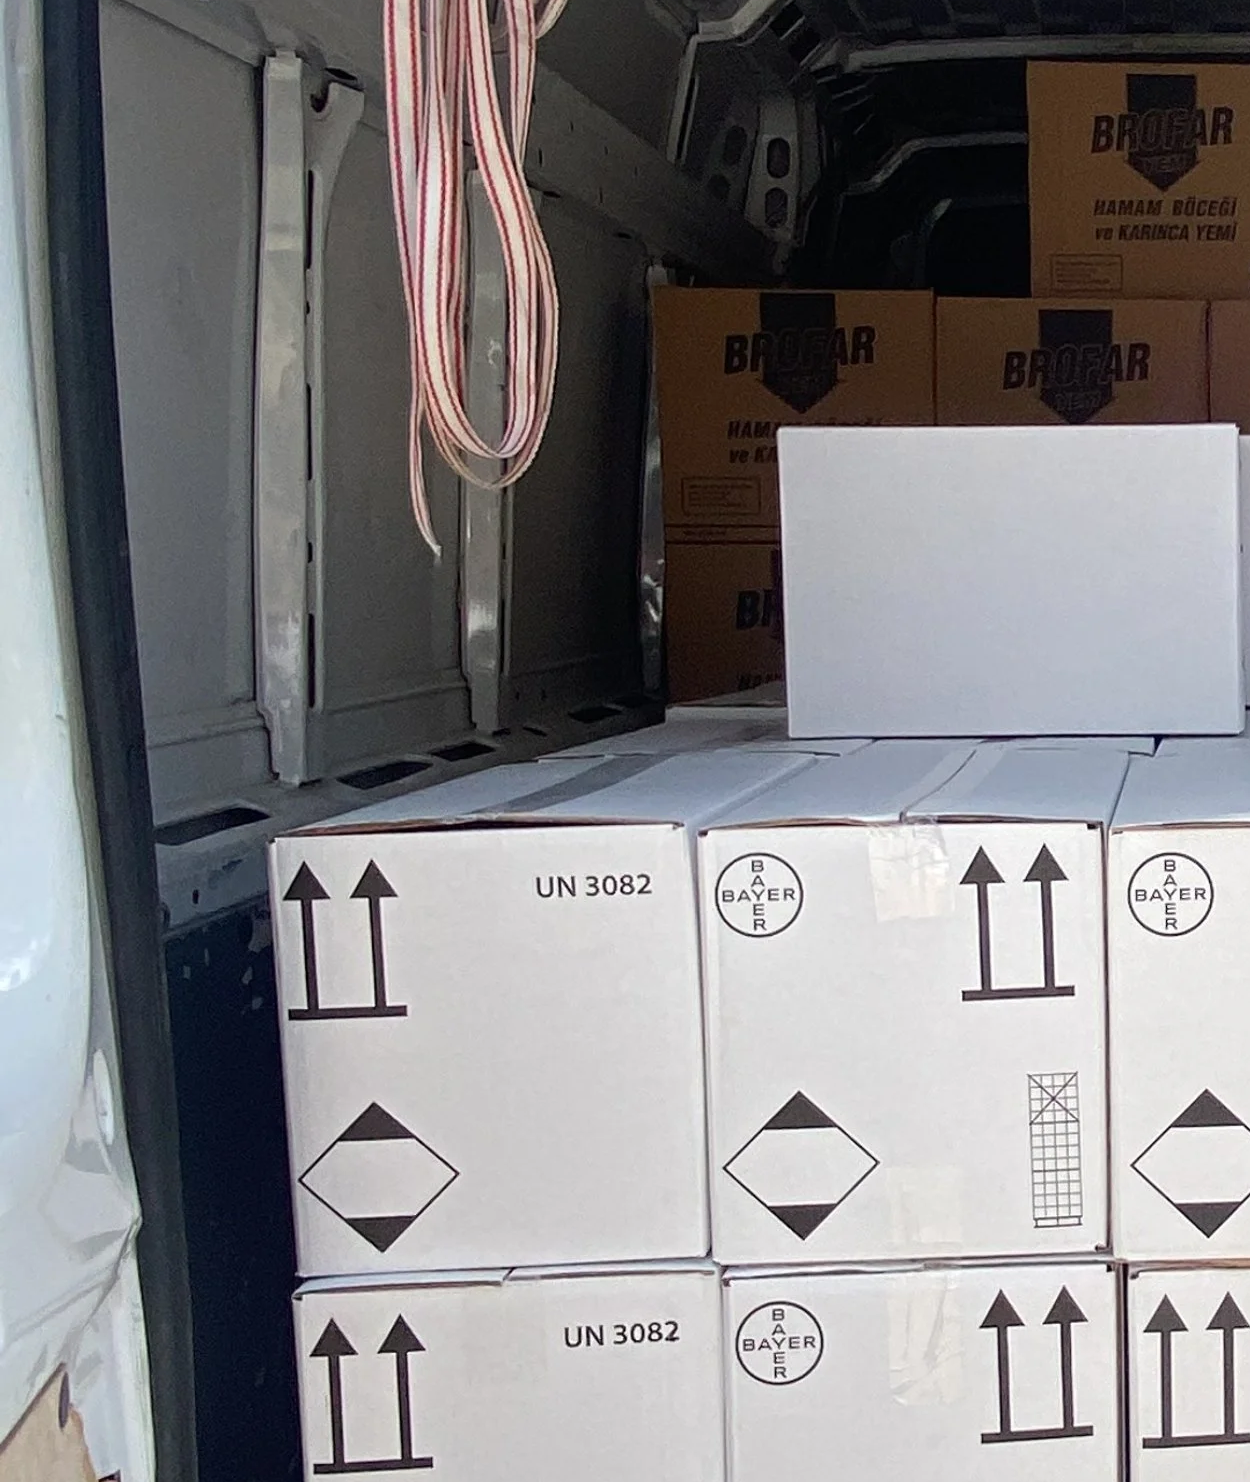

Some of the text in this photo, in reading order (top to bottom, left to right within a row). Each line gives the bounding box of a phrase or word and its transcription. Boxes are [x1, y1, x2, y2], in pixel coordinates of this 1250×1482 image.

[1090, 105, 1235, 155] BROFAR
[1093, 198, 1164, 217] HAMAM
[1095, 227, 1114, 241] ve
[1117, 224, 1190, 242] KARINCA
[723, 325, 877, 376] BROFAR
[1002, 342, 1151, 391] BROFAR
[536, 873, 652, 898] UN 3082
[722, 889, 796, 903] BAYER
[751, 860, 767, 931] BAYER
[1134, 887, 1207, 902] BAYER
[1163, 859, 1178, 930] BAYER
[564, 1321, 680, 1348] UN 3082
[742, 1335, 817, 1351] BAYER
[770, 1308, 787, 1379] BAYER
